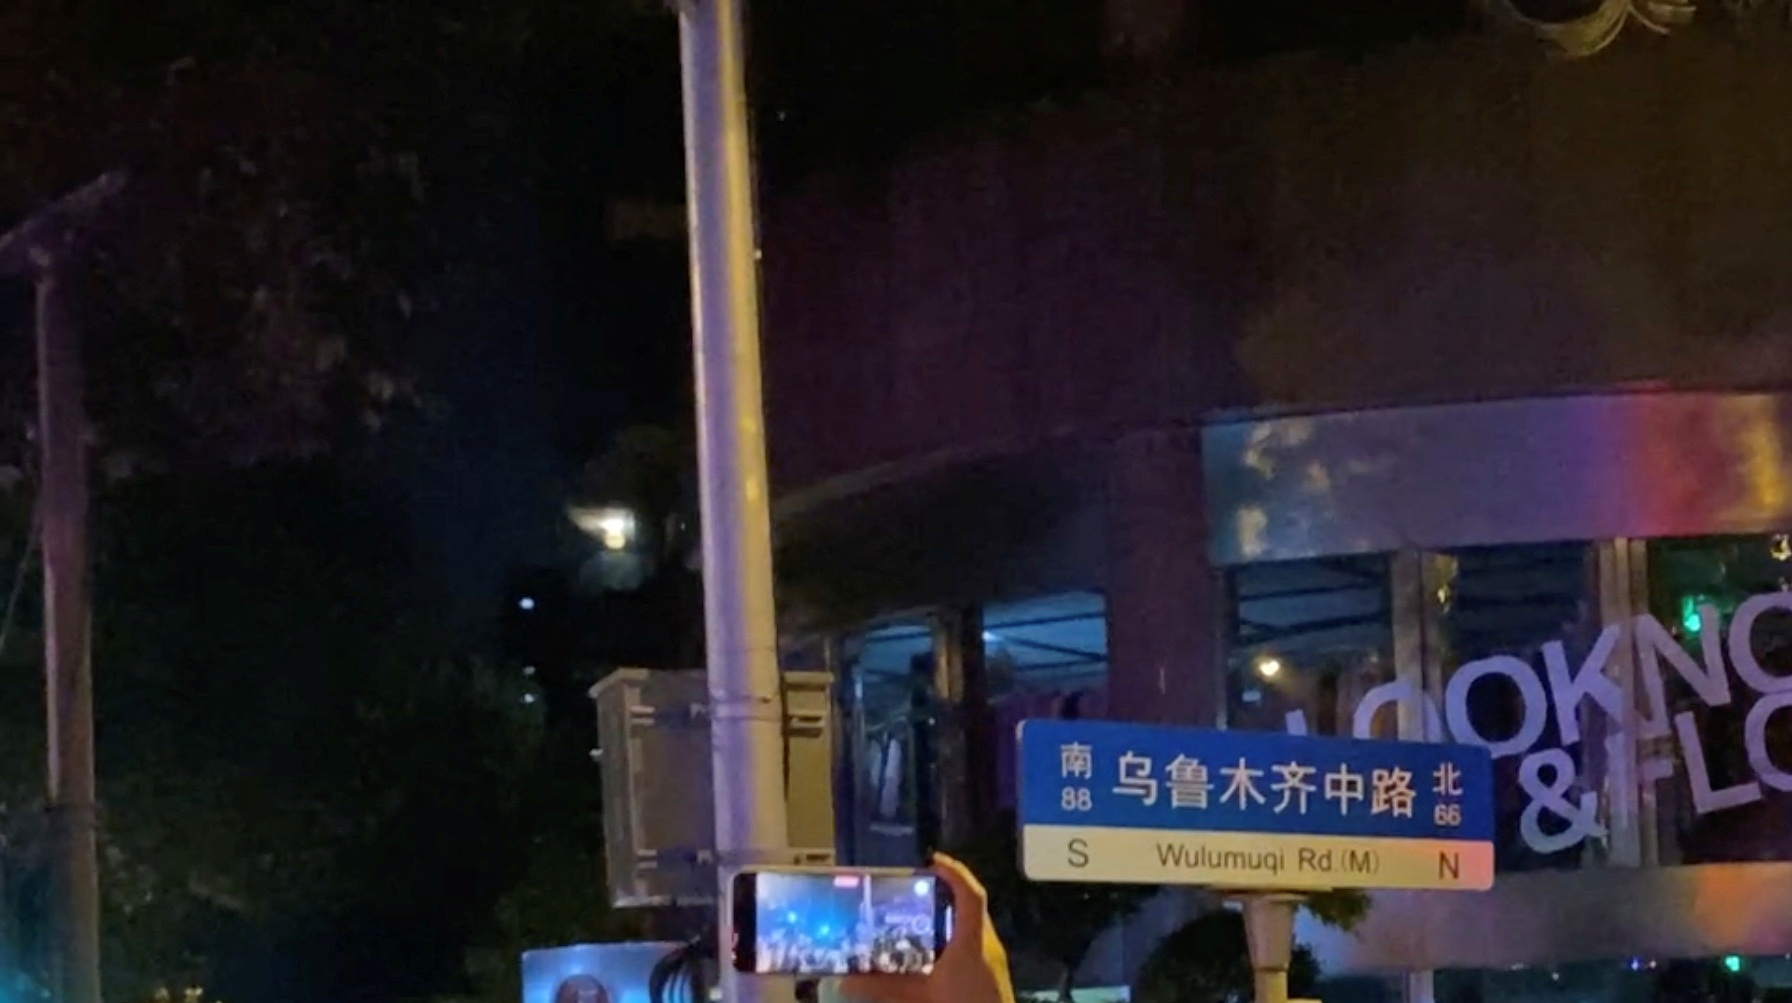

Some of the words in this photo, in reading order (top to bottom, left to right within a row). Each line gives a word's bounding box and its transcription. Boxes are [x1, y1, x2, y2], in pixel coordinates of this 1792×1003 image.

[1060, 742, 1092, 779] 南
[1112, 751, 1417, 818] 乌鲁木齐中路
[1432, 762, 1463, 796] 北
[1061, 786, 1092, 811] 88
[1518, 748, 1608, 854] &
[1434, 804, 1462, 826] 66
[1067, 838, 1089, 868] S
[1157, 843, 1284, 876] Wulumuqi
[1439, 852, 1460, 880] N
